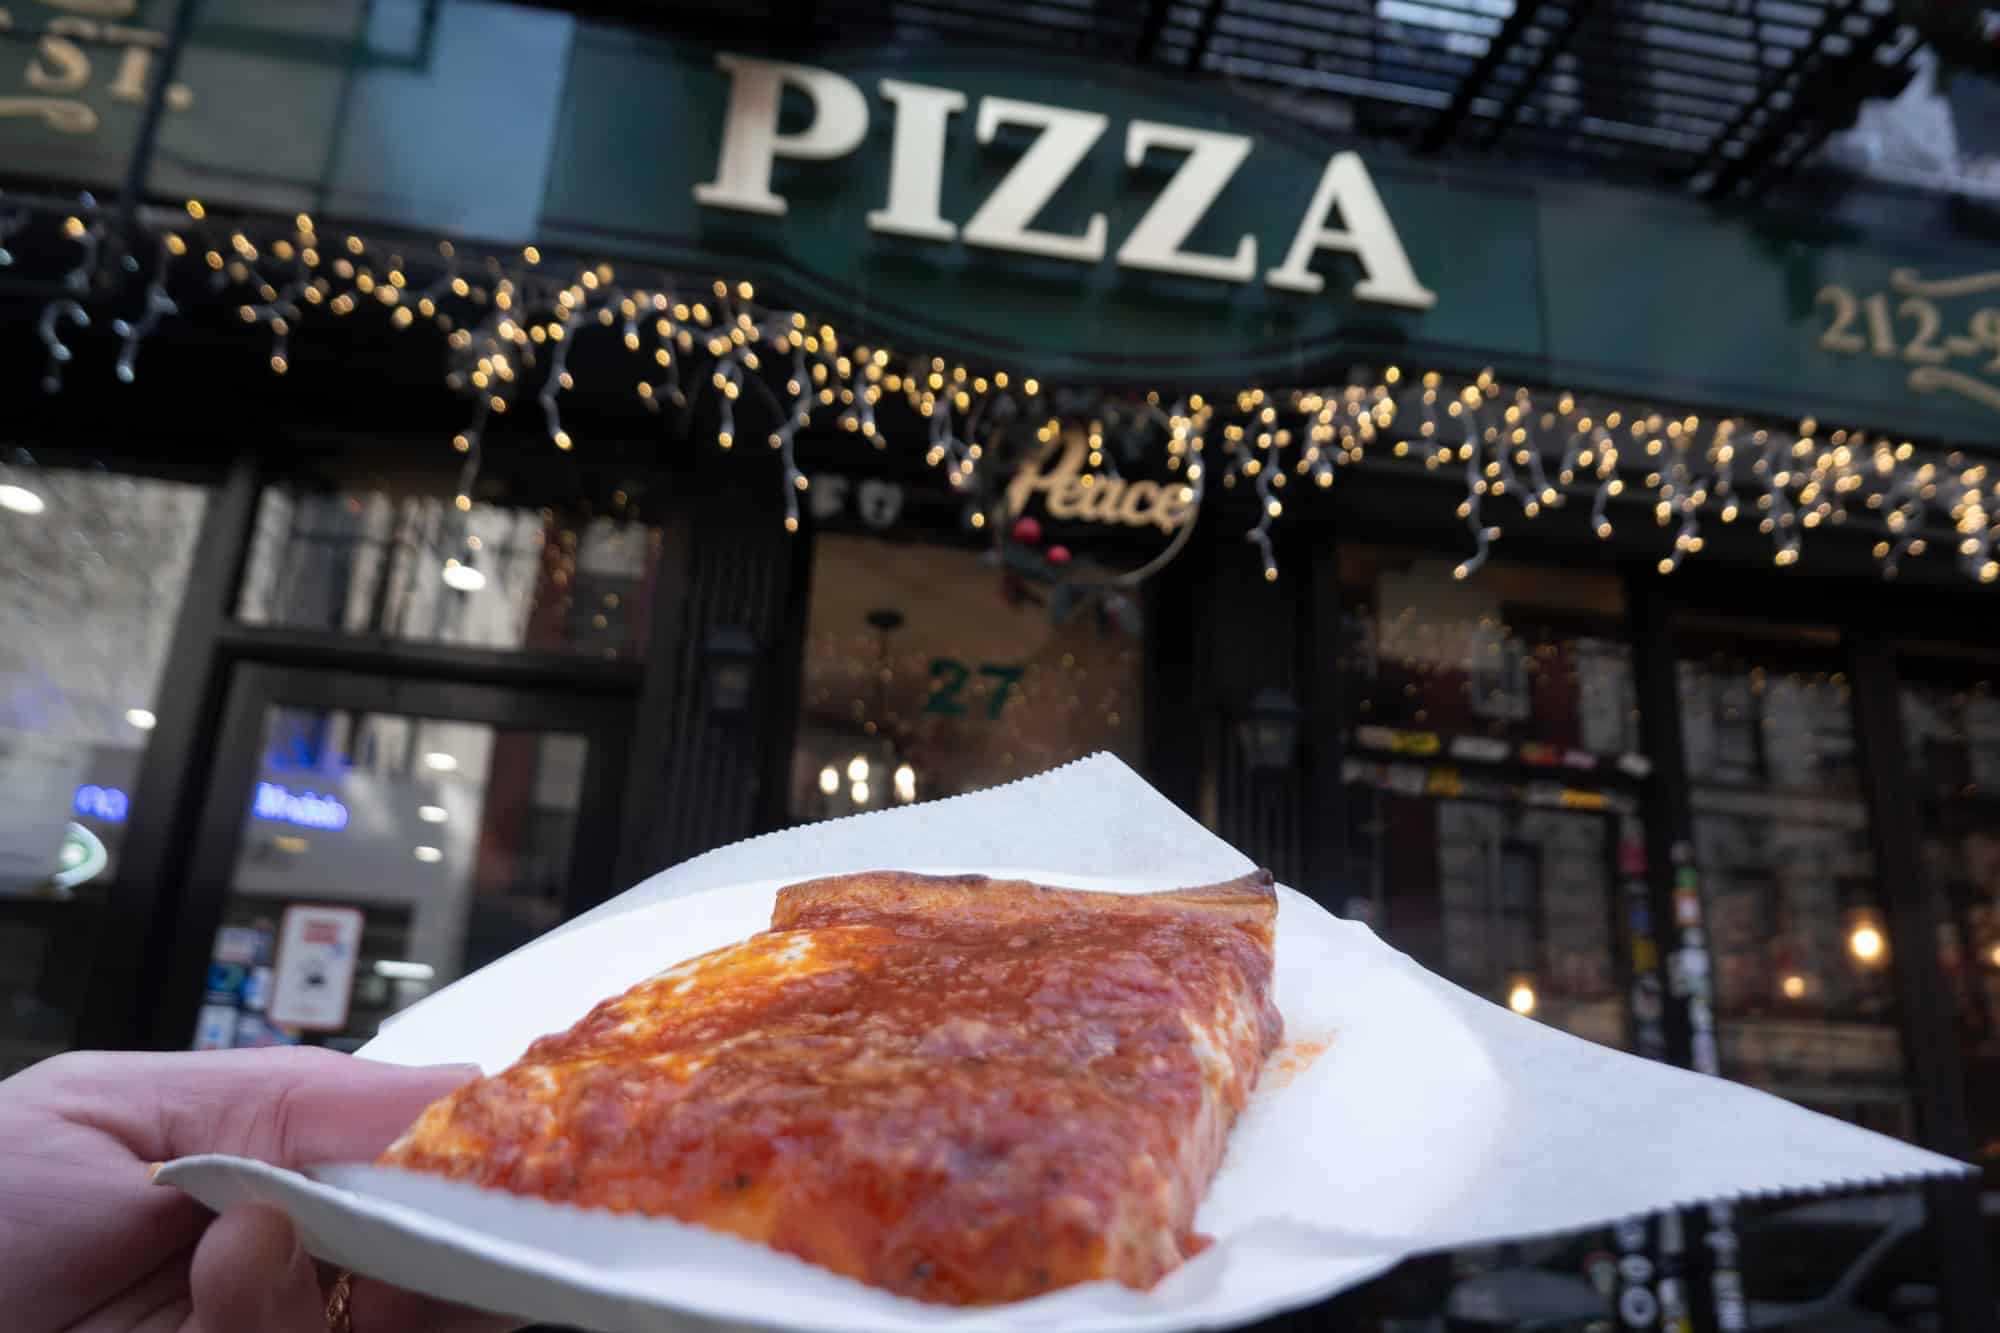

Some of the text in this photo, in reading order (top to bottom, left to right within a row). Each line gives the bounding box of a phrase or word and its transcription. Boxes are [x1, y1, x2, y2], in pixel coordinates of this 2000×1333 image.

[27, 16, 193, 111] ST.
[693, 53, 1436, 308] PIZZA
[1008, 428, 1194, 534] Peace
[926, 660, 1024, 720] 27
